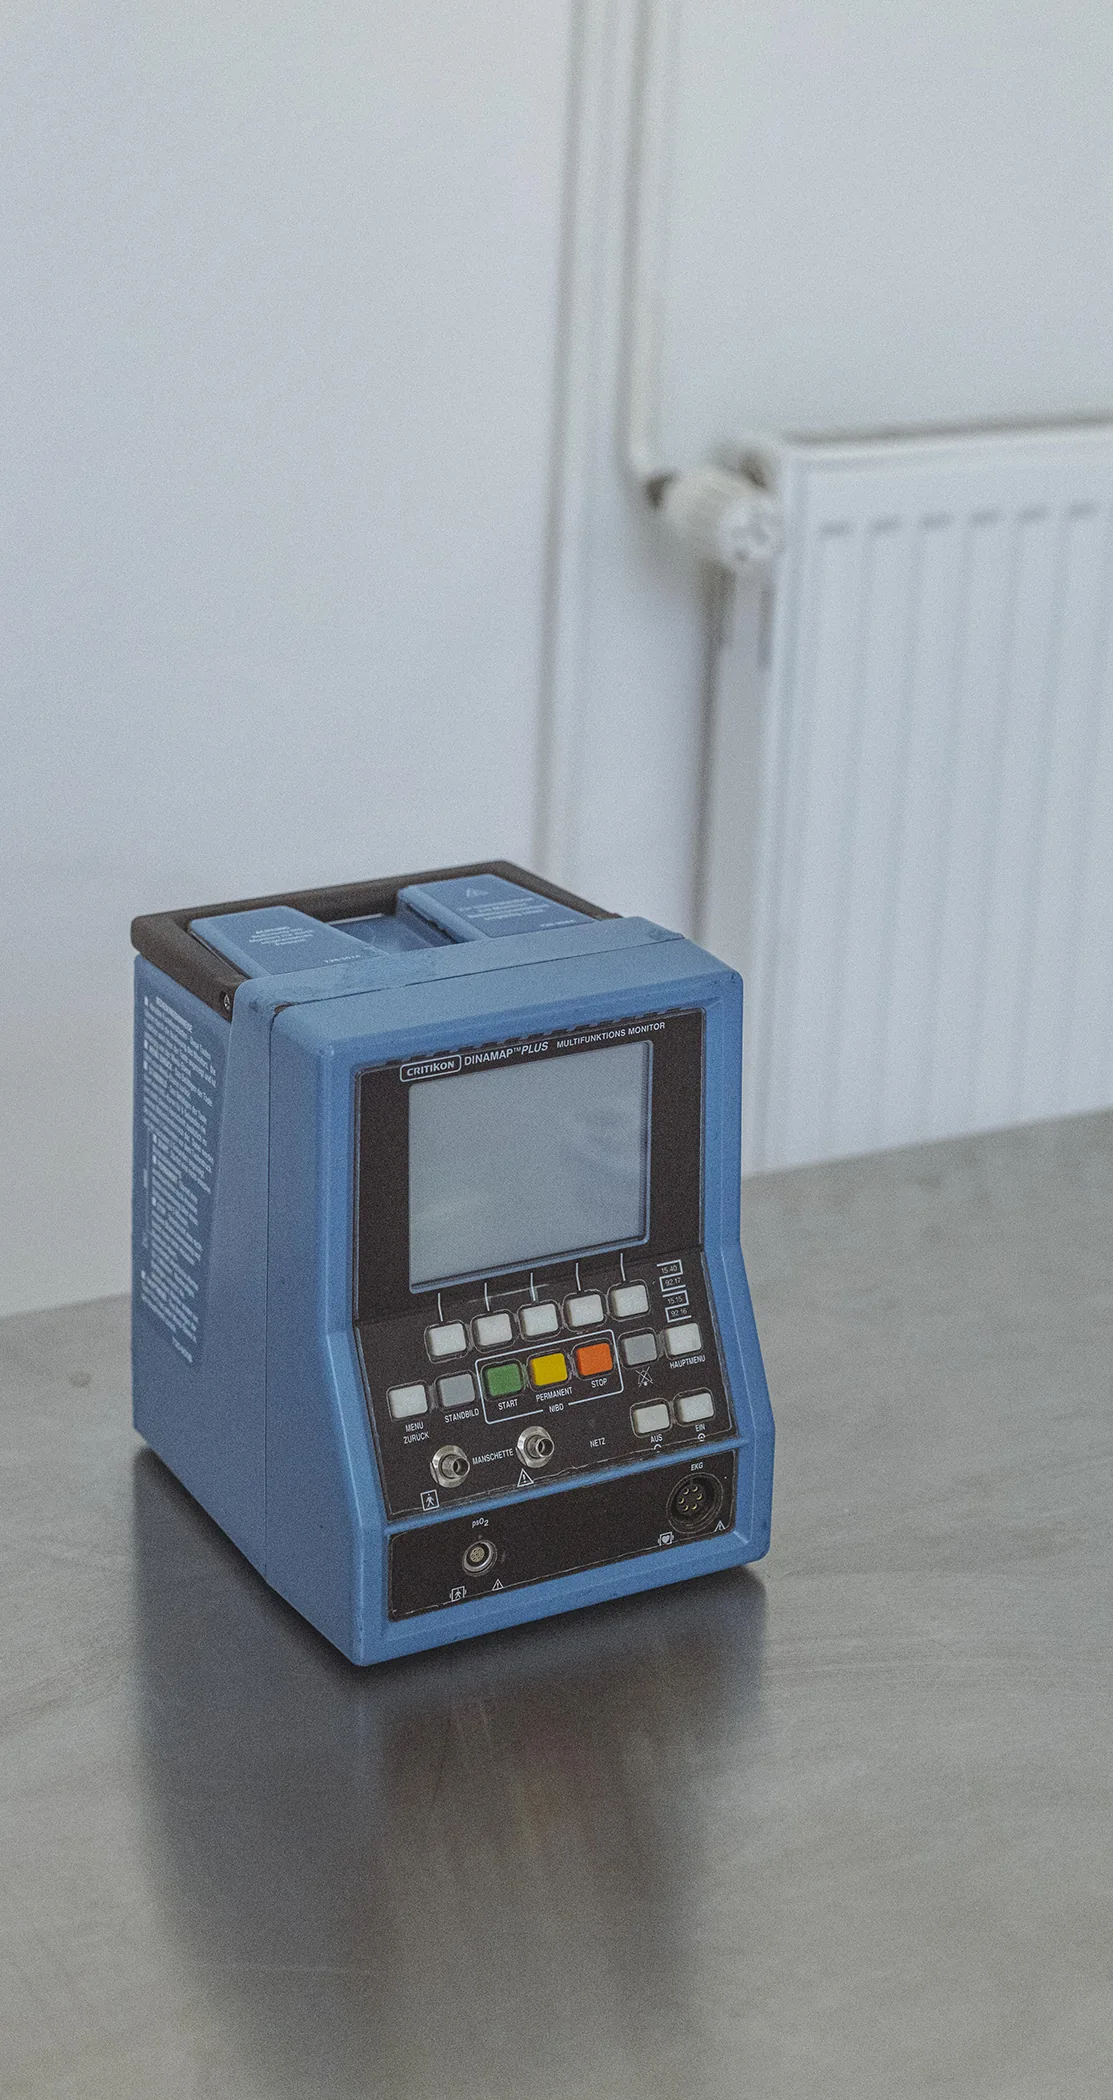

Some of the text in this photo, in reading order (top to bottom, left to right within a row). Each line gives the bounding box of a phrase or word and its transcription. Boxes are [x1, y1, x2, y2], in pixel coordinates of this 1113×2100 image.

[406, 1060, 456, 1077] CRITIKON
[556, 1029, 626, 1049] MULTIFUNKTIONS
[628, 1021, 666, 1036] MONITOR
[591, 1378, 608, 1389] STOP
[535, 1386, 573, 1402] PERMANENT
[498, 1398, 518, 1411] START
[444, 1407, 480, 1424] STANDBILD
[405, 1421, 424, 1433] MENU
[695, 1422, 706, 1432] EIN
[589, 1437, 606, 1448] NETZ
[650, 1433, 663, 1444] AUS
[472, 1448, 514, 1466] MANSCHETTE
[691, 1462, 704, 1471] EKG
